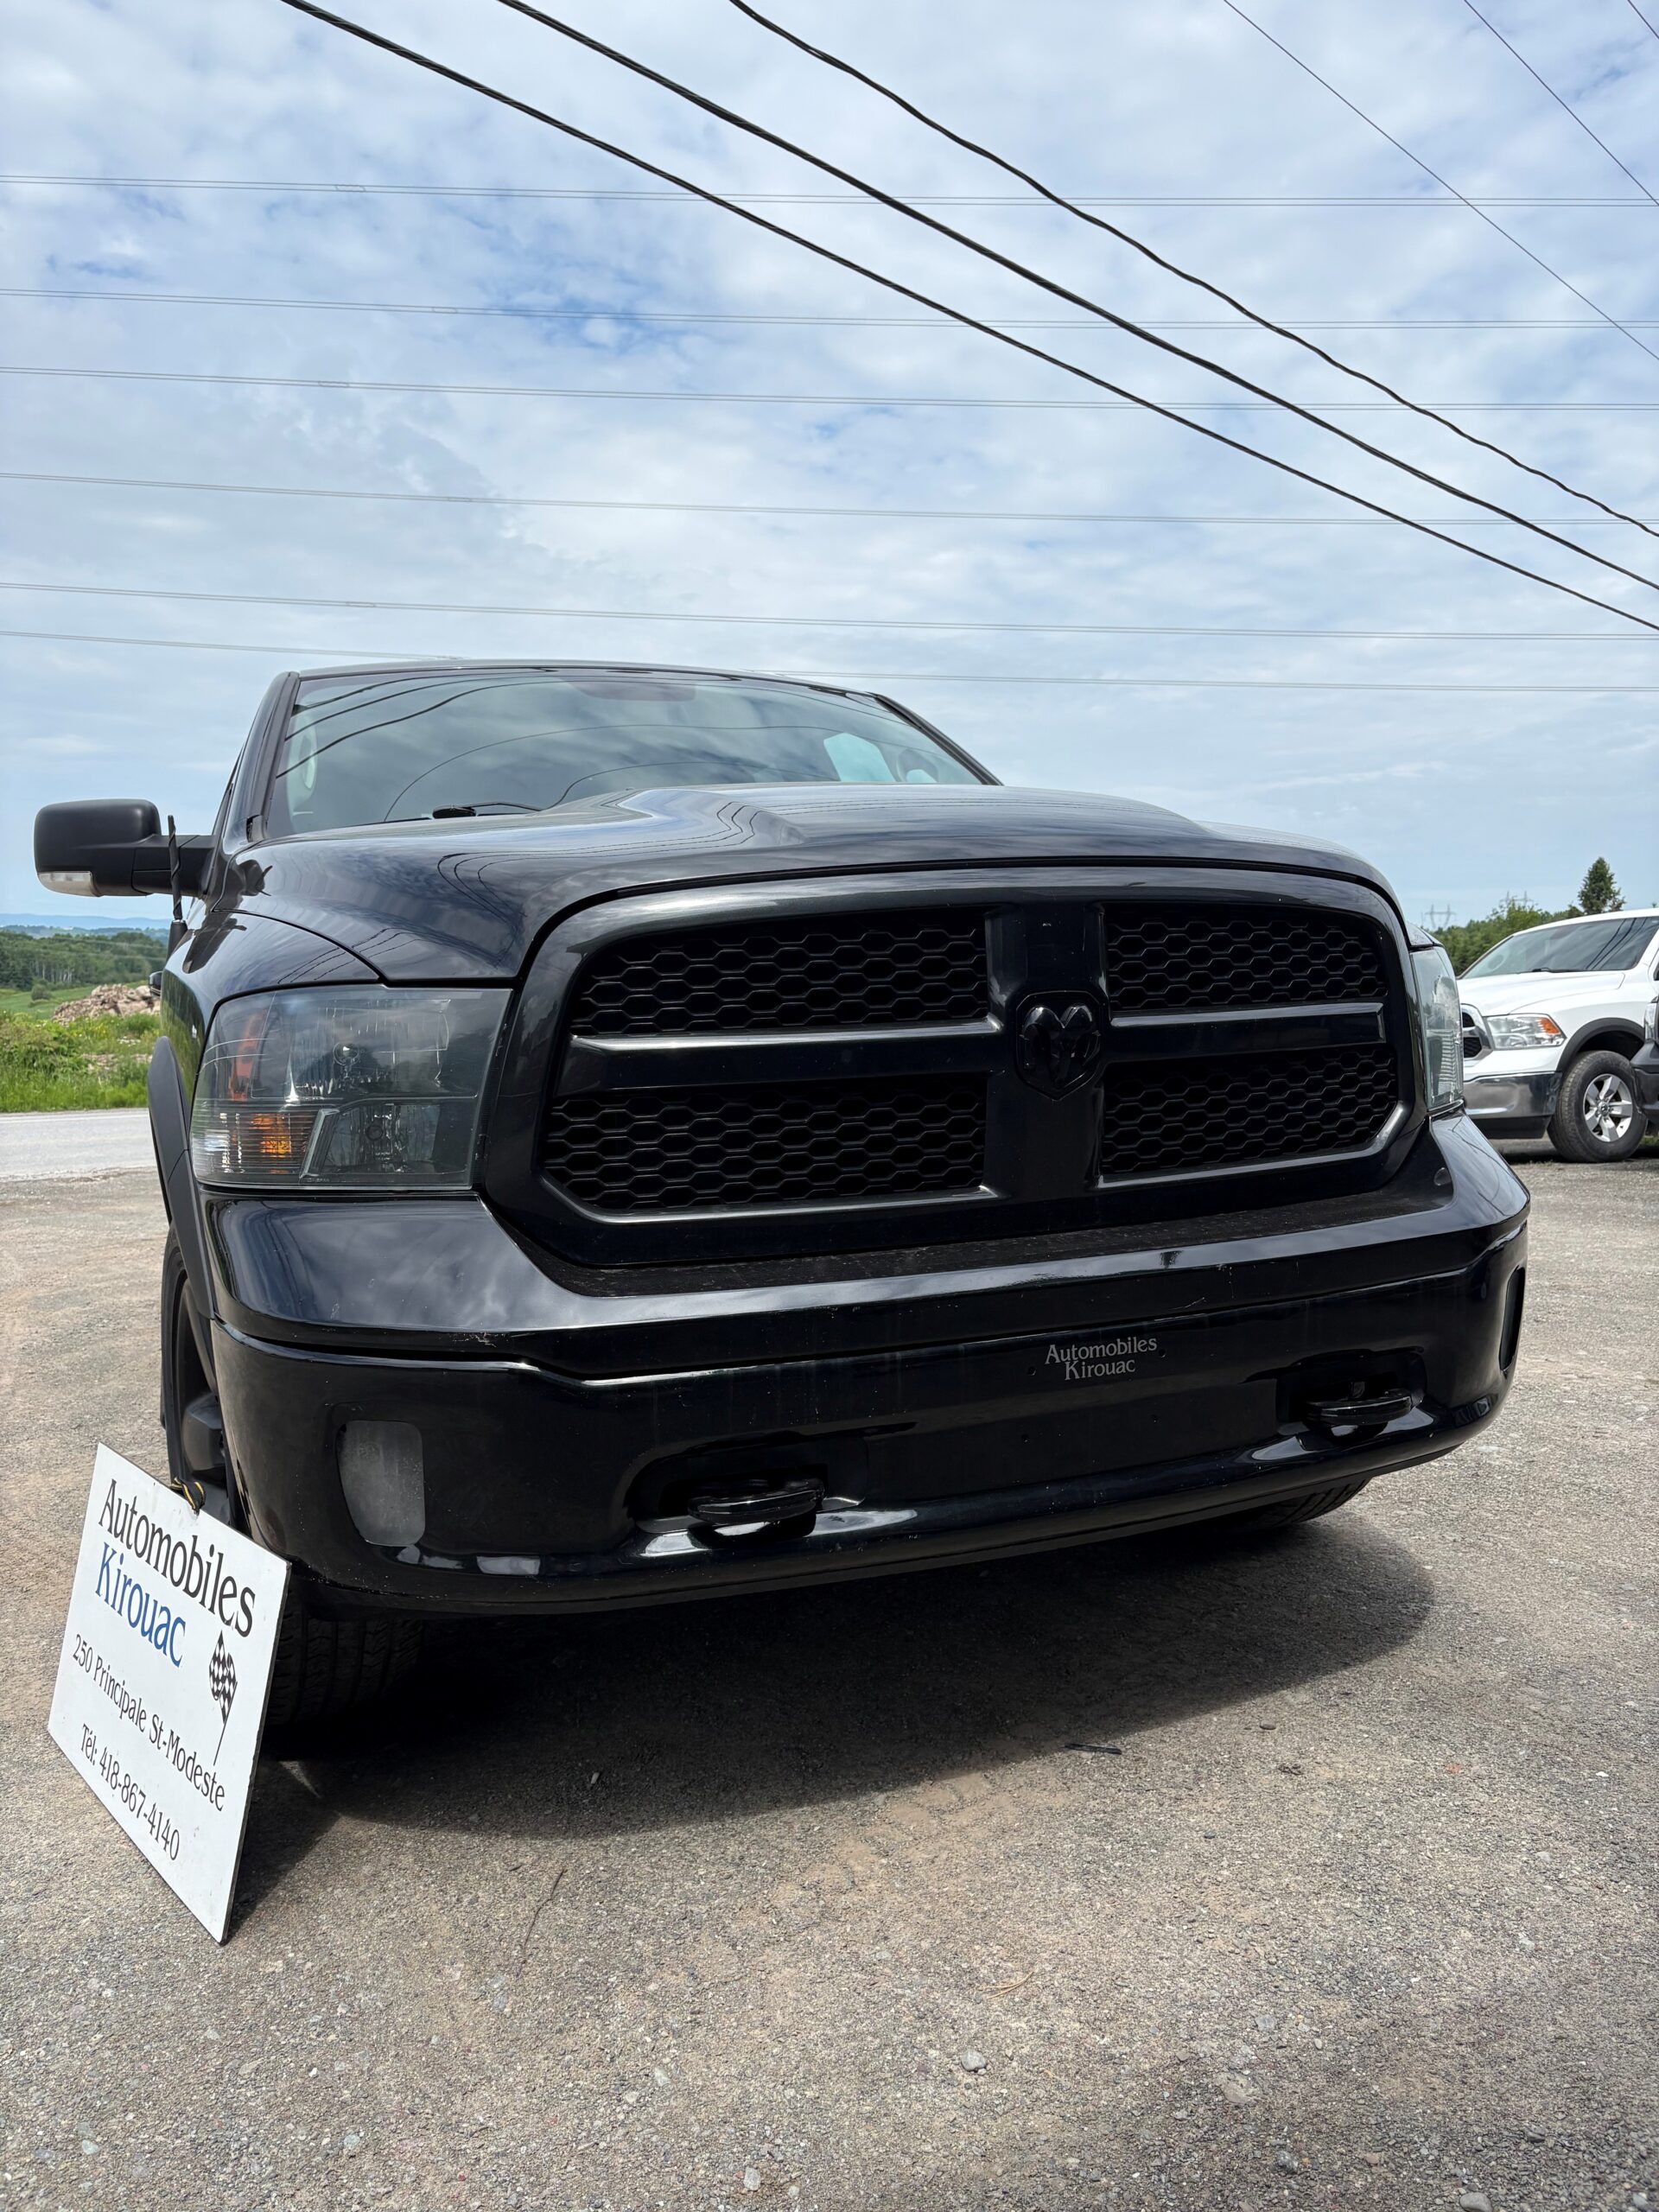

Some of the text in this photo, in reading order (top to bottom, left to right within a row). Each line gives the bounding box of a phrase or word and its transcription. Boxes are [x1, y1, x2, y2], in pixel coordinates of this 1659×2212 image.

[1045, 1337, 1158, 1364] Automobiles
[1065, 1359, 1136, 1381] Kirouac
[95, 1541, 186, 1668] Kirouac
[99, 1478, 256, 1637] Automobiles
[73, 1634, 225, 1811] 250 Principale St-Modeste
[81, 1723, 180, 1860] Tél: 418-867-4140
